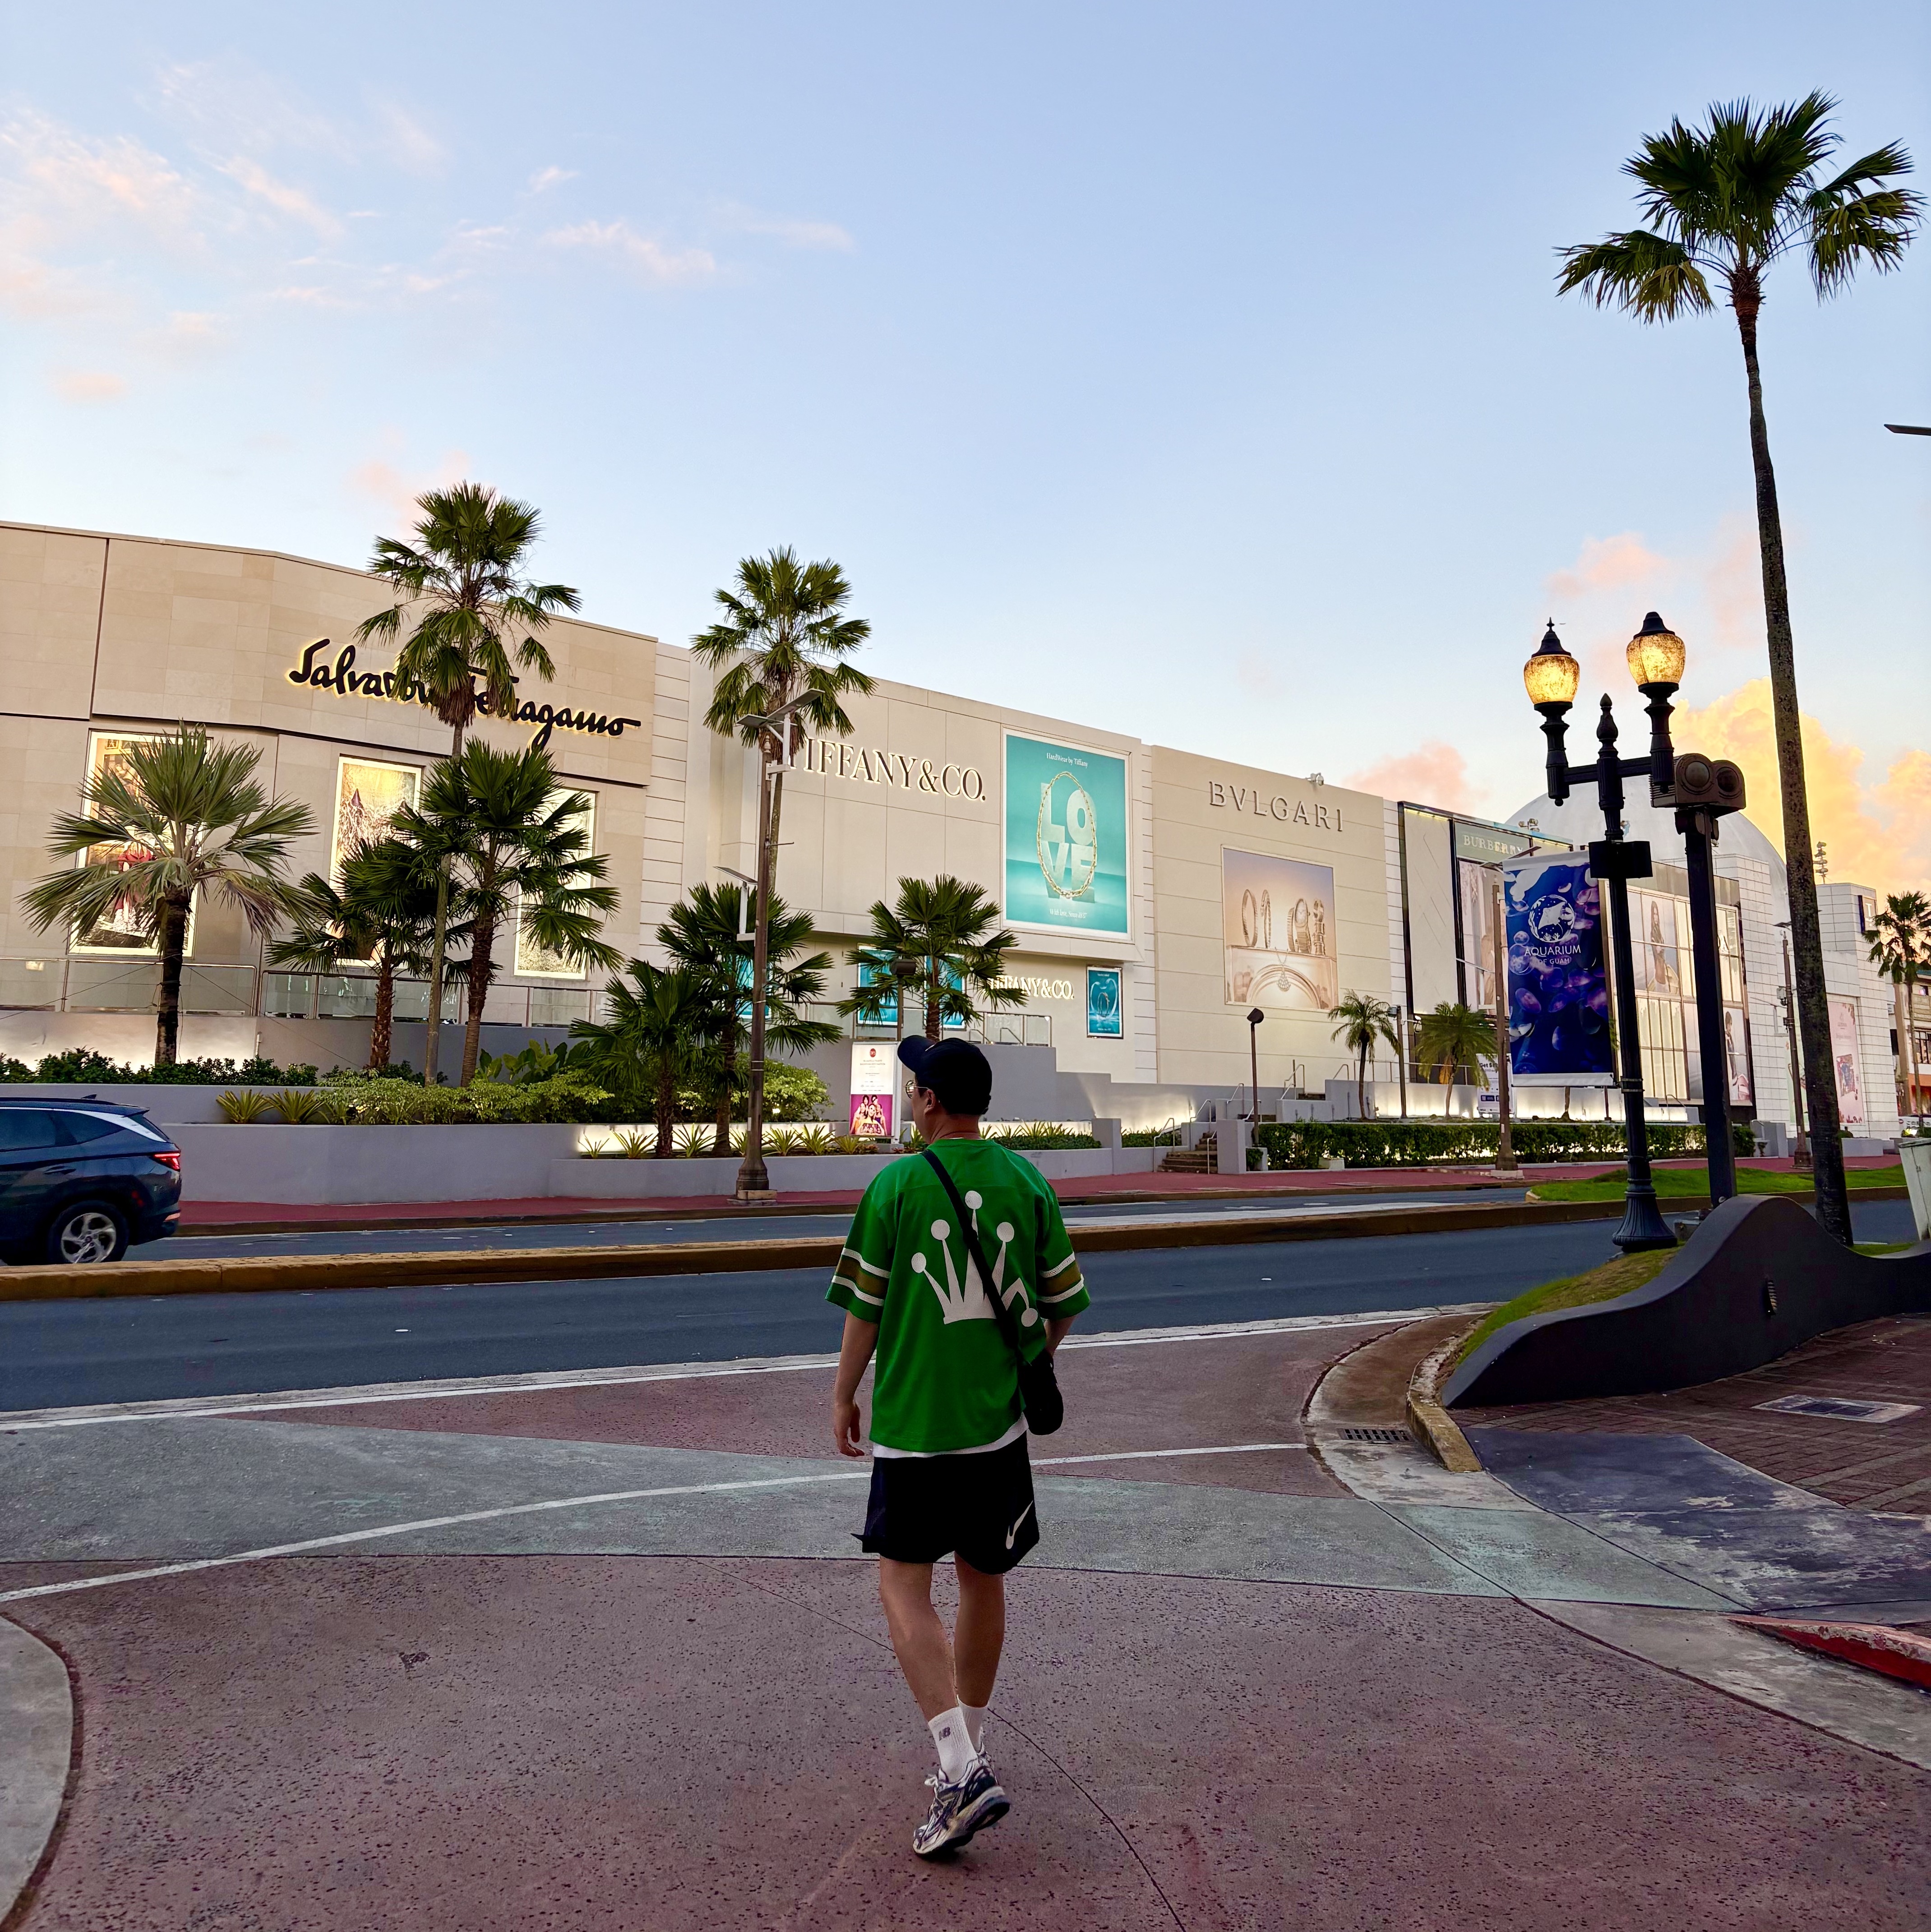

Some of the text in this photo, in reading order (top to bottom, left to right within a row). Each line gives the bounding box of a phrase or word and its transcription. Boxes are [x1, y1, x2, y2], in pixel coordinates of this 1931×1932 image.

[289, 638, 439, 707] Salvaor
[788, 738, 986, 802] IFFANY&CO.
[1046, 752, 1088, 769] HardWear by Tiffany
[1208, 781, 1344, 832] BVLGARI
[1463, 834, 1524, 855] BURBERRY
[1524, 944, 1581, 957] AQUARIUM
[986, 975, 1075, 1000] IFFANY&CO.
